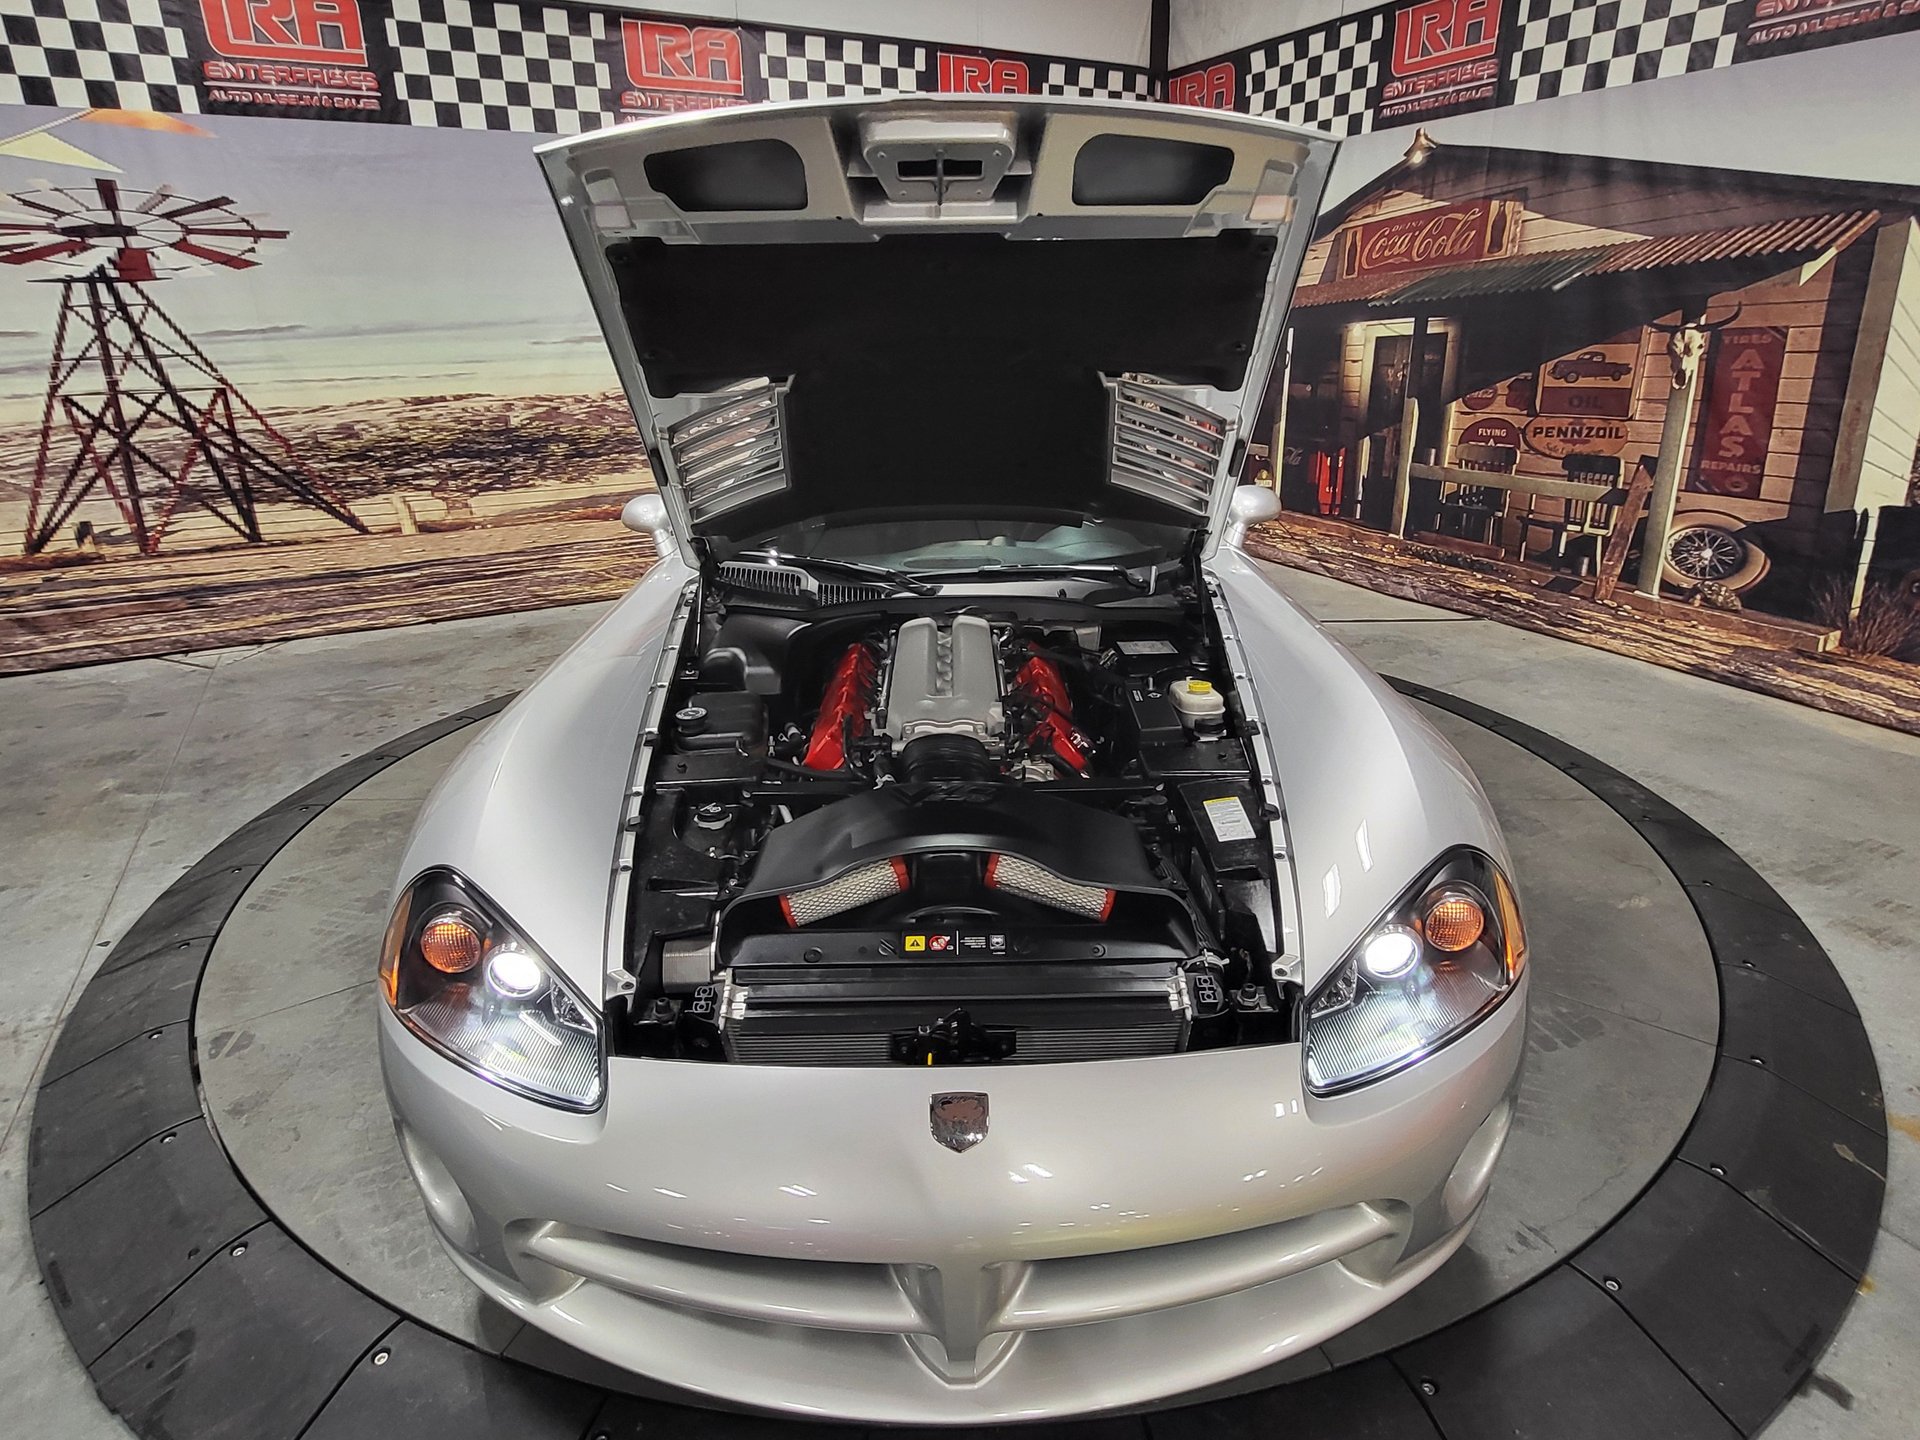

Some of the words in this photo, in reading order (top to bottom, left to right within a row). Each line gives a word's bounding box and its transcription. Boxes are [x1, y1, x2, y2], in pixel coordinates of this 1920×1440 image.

[1747, 24, 1797, 46] AUTO
[203, 60, 379, 90] ENTERPRISES
[1383, 59, 1499, 99] ENTERPRISES
[208, 89, 253, 102] AUTO
[1722, 333, 1773, 344] TIRES
[1568, 395, 1603, 410] OIL
[1718, 348, 1766, 458] ATLAS
[1478, 427, 1507, 437] FLYING
[1532, 425, 1625, 440] PENNZOIL
[1701, 459, 1761, 475] REPAIRS
